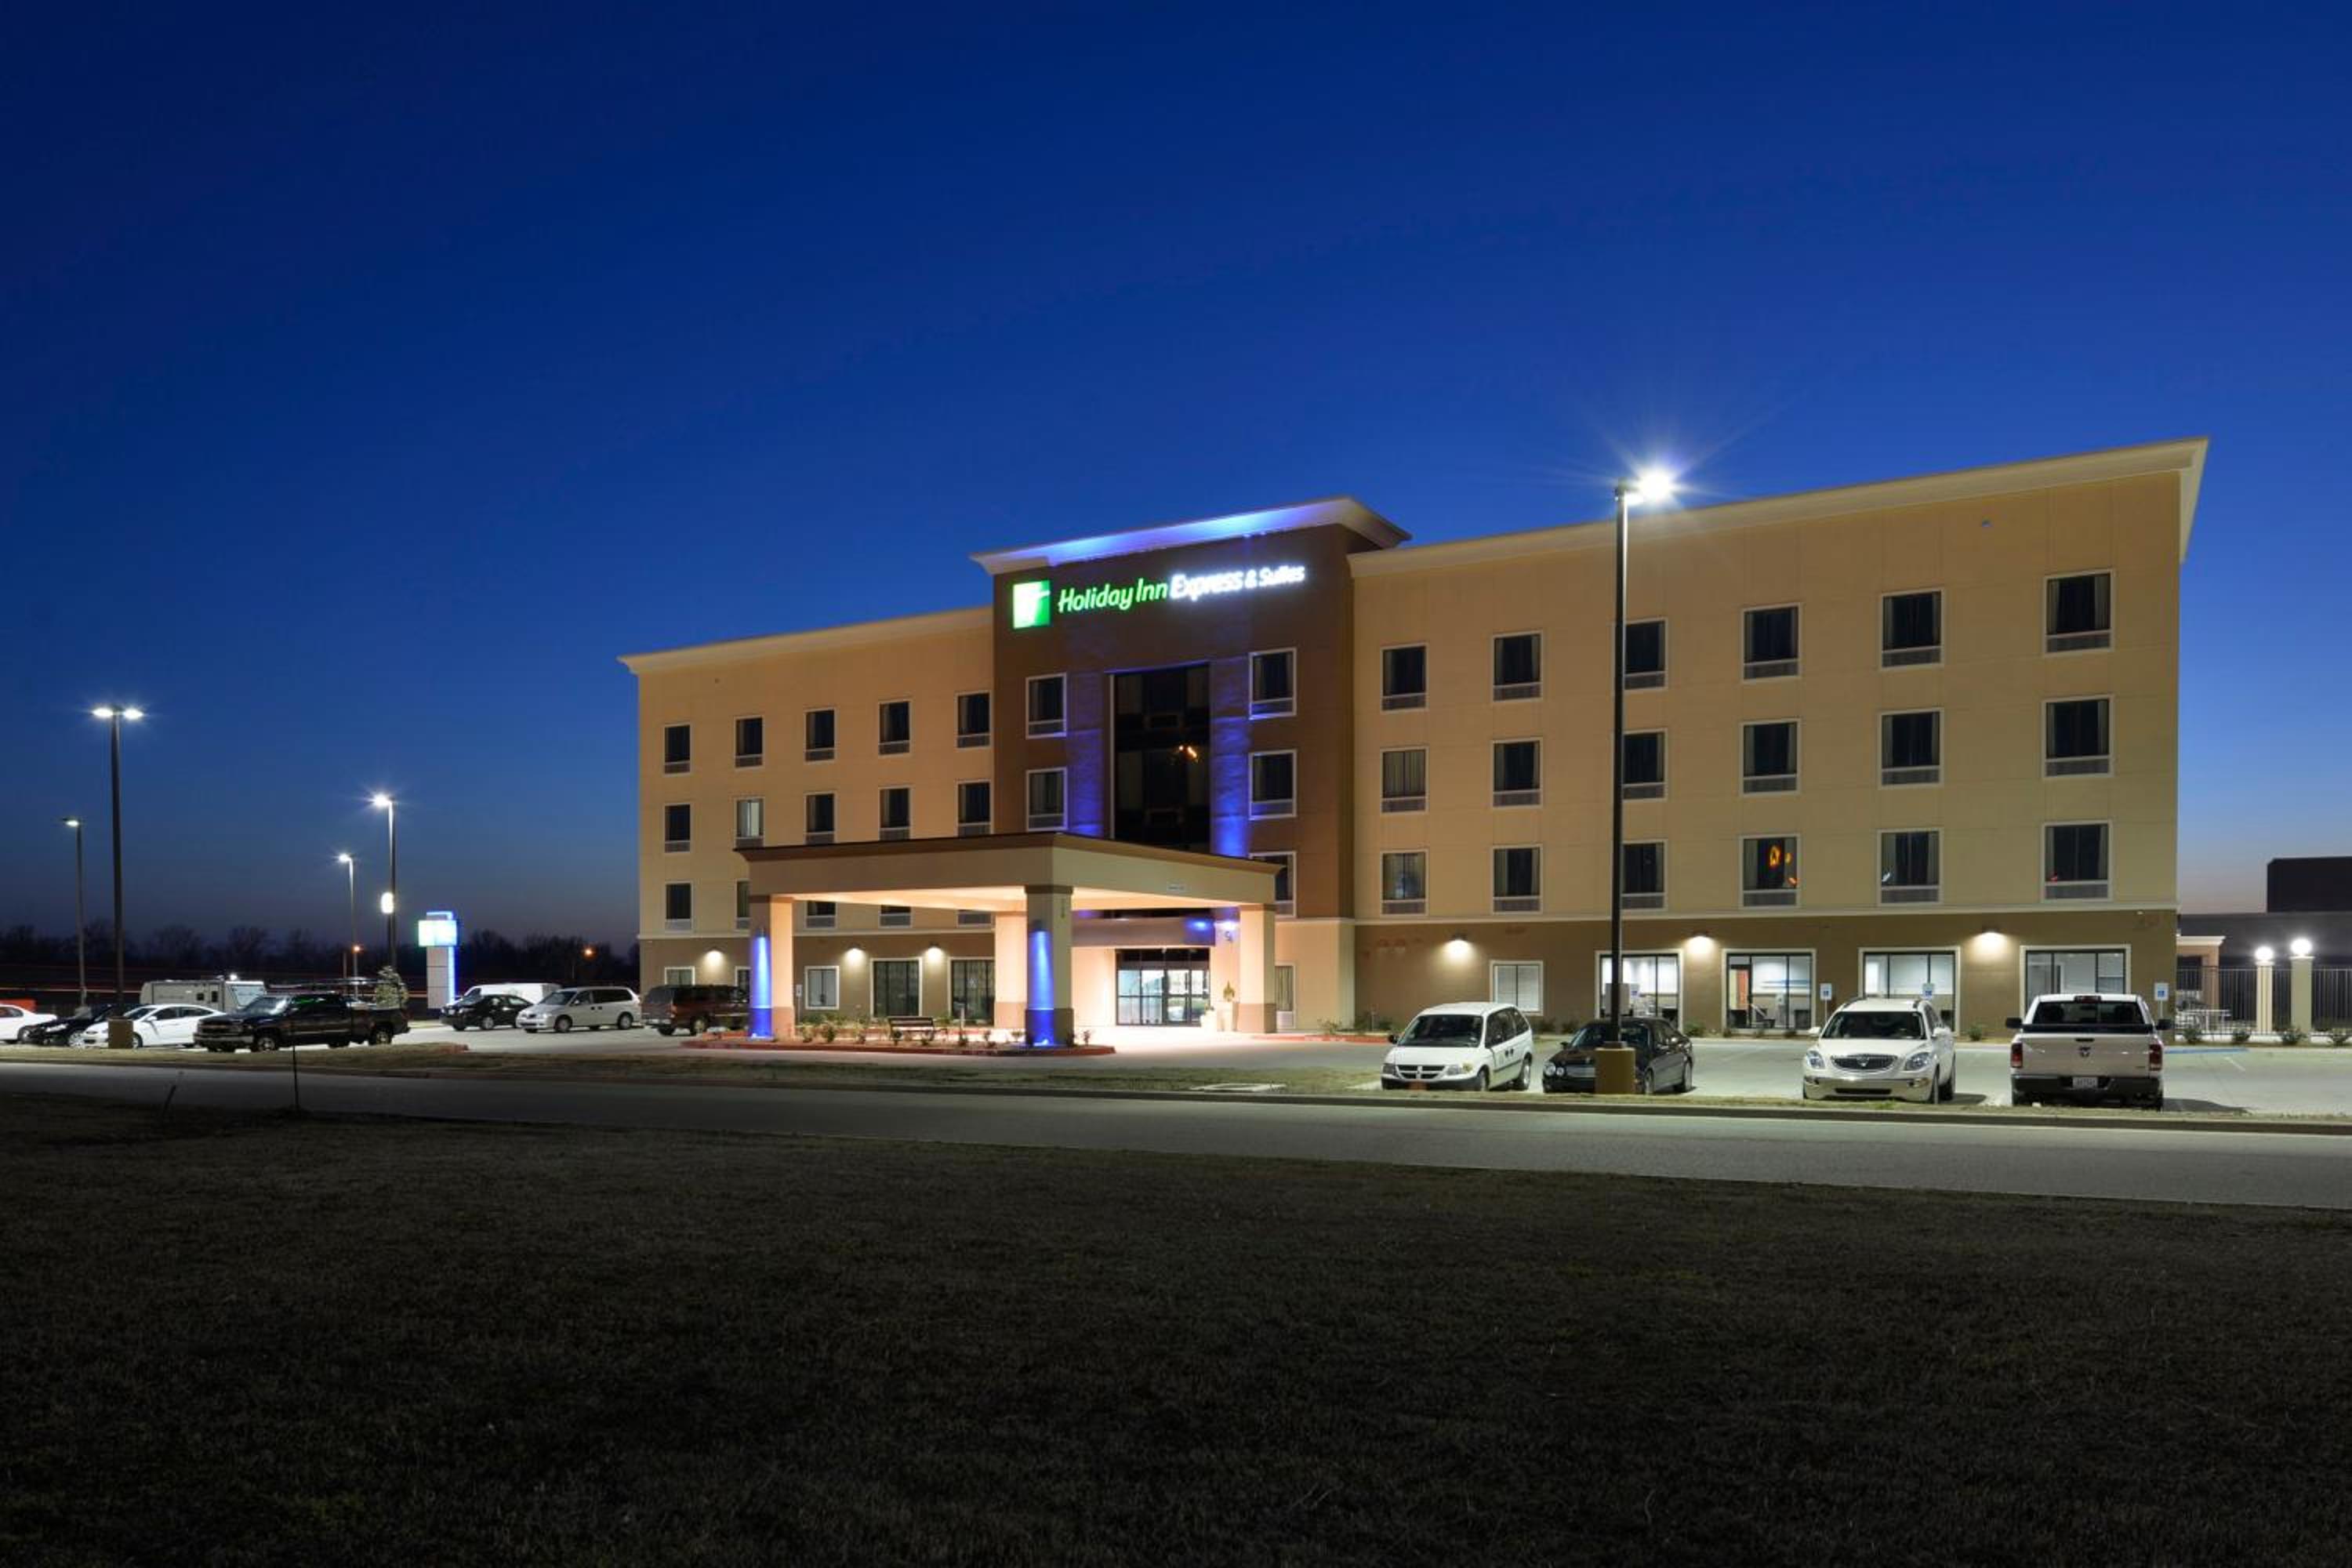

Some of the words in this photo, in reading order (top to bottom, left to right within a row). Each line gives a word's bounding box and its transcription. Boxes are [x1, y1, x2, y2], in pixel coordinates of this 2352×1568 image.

[1058, 583, 1134, 613] Holiday
[1135, 578, 1168, 603] Inn
[1170, 571, 1244, 601] Express
[1245, 568, 1257, 588] &
[1258, 565, 1305, 587] Suites
